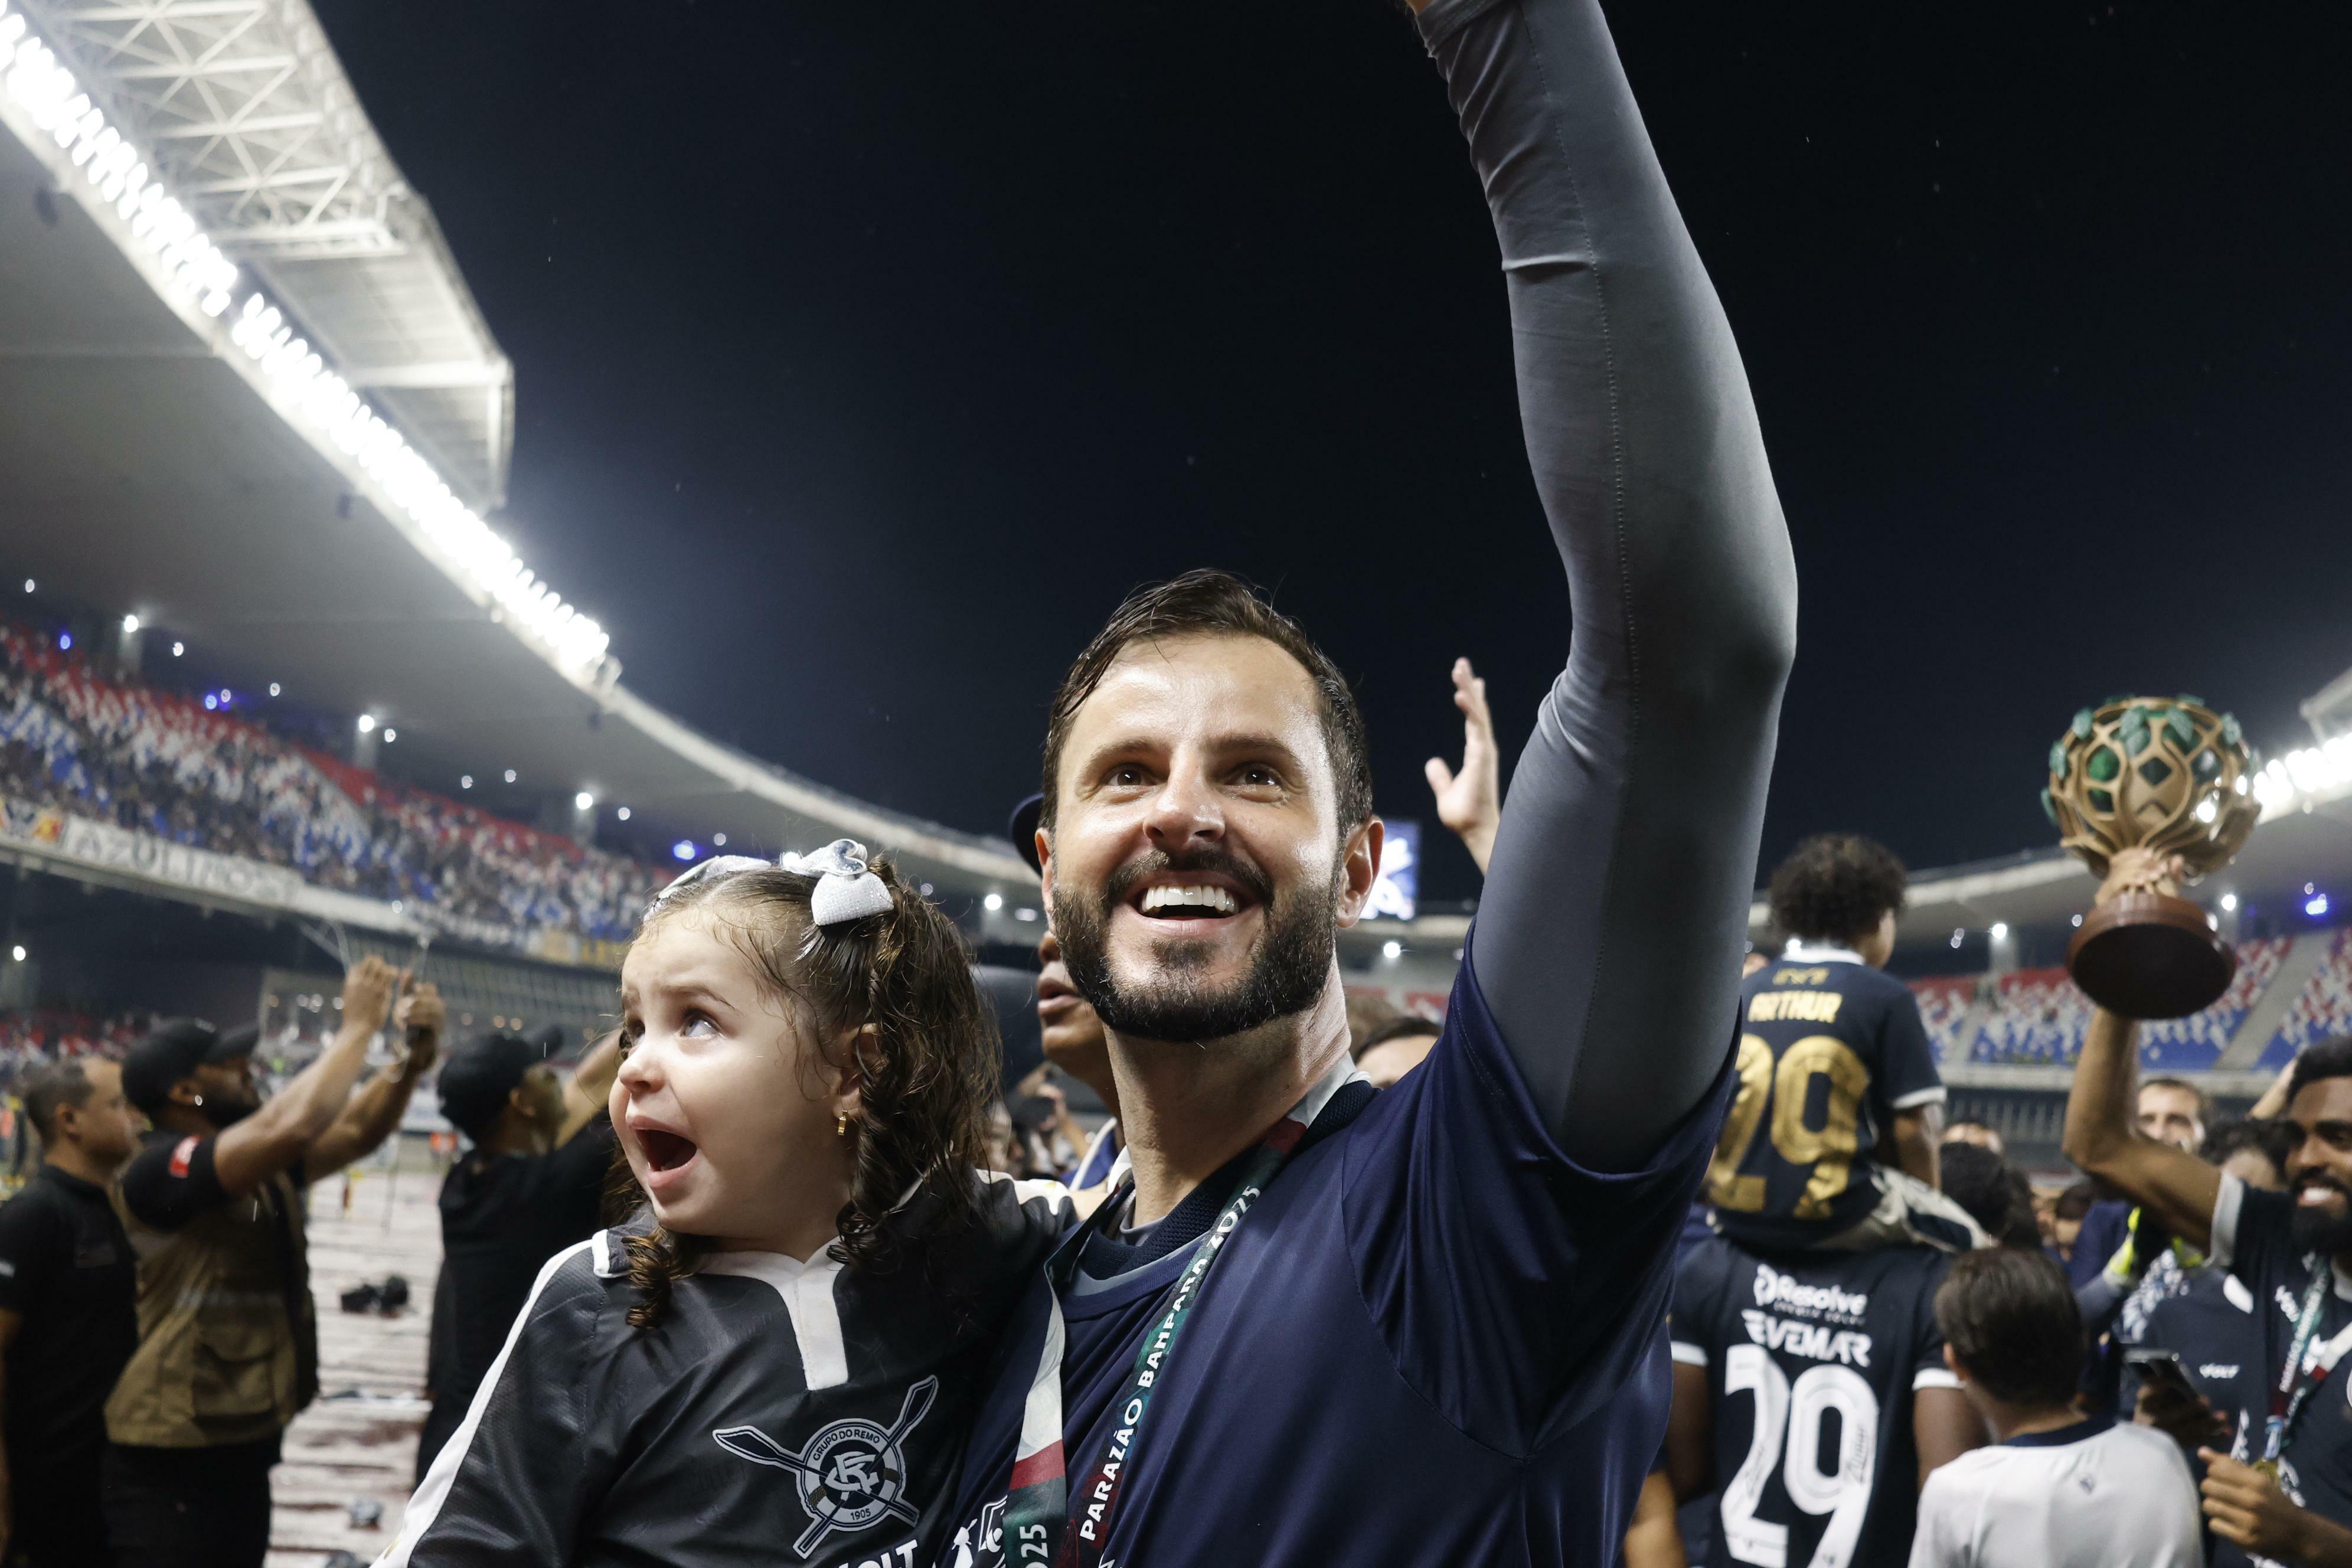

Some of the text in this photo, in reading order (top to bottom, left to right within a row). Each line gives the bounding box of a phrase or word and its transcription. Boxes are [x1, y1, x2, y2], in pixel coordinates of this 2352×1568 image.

[1747, 990, 1843, 1023] ARTHUR
[1741, 1308, 1873, 1368] EVEMAR
[1080, 1398, 1143, 1541] PARAZÃO
[1206, 1185, 1260, 1250] 2025
[813, 1429, 880, 1461] GRUPO DO REMO
[1720, 1343, 1879, 1568] 29
[850, 1508, 871, 1521] 1905
